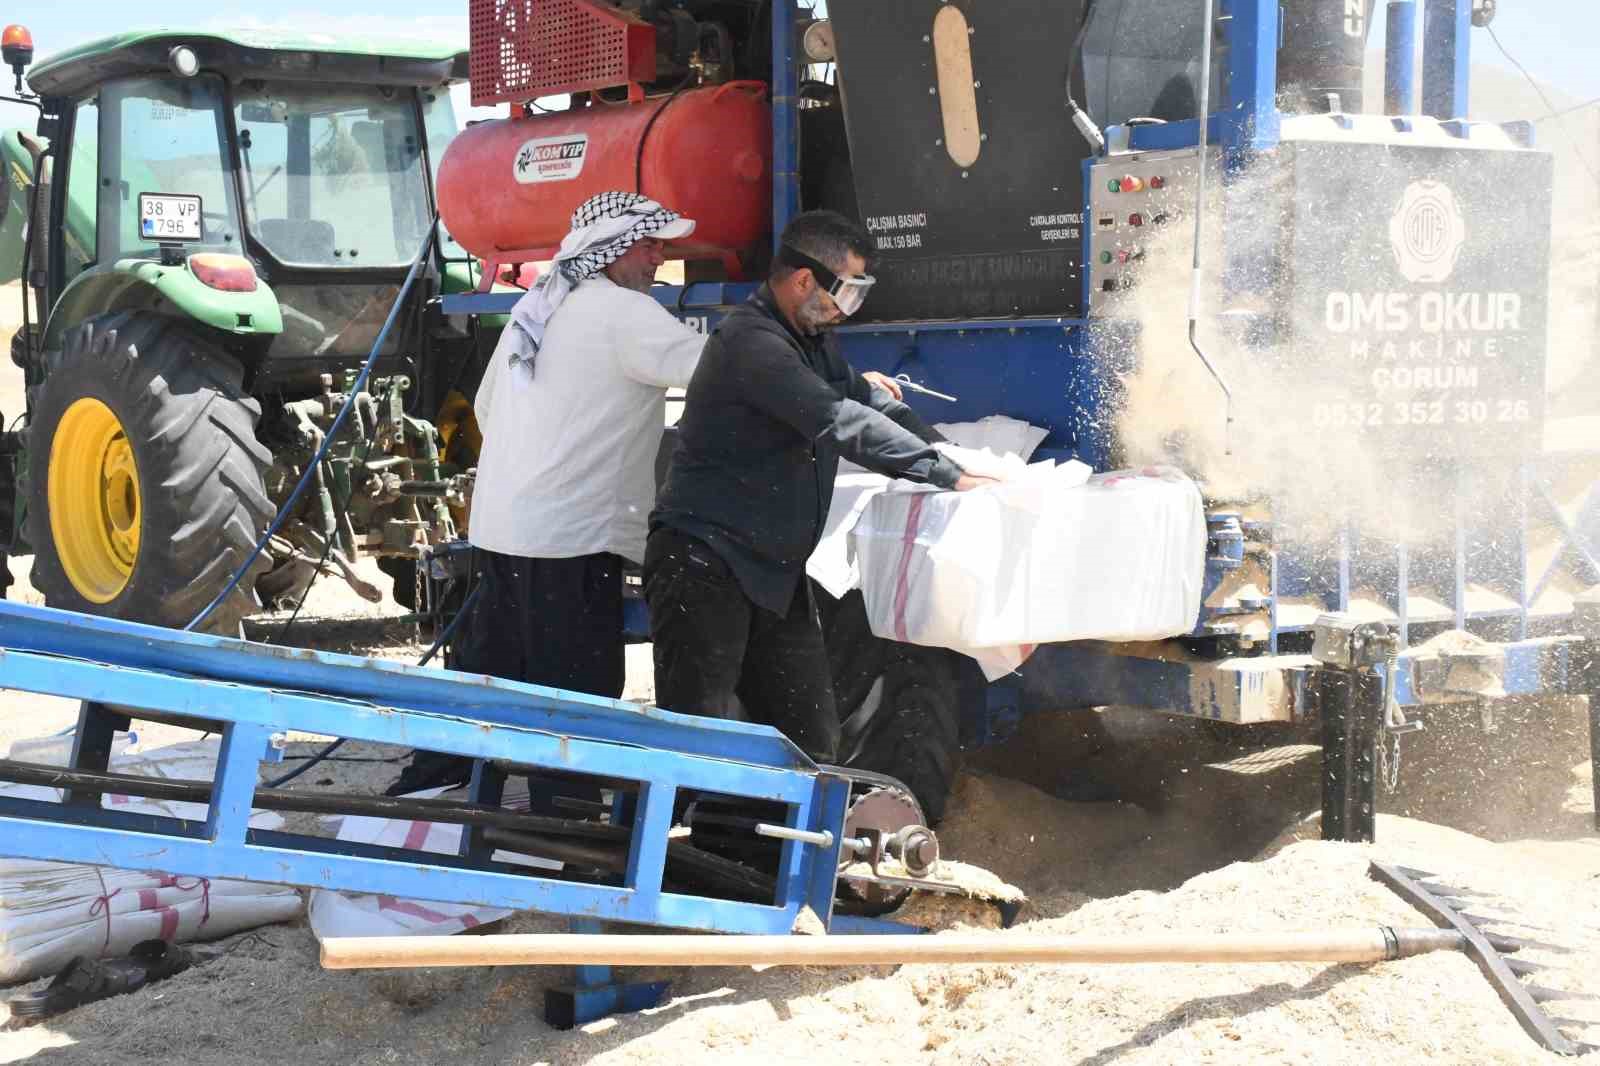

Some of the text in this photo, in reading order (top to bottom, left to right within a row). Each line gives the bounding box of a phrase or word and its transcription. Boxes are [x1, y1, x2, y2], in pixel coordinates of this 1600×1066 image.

[145, 201, 197, 217] 38 VP
[157, 218, 185, 233] 796
[898, 212, 928, 229] BASINCI
[905, 233, 922, 248] BAR
[1326, 291, 1521, 333] OMS OKUR
[1392, 400, 1445, 425] 352
[1454, 400, 1488, 423] 30
[1496, 399, 1530, 422] 26
